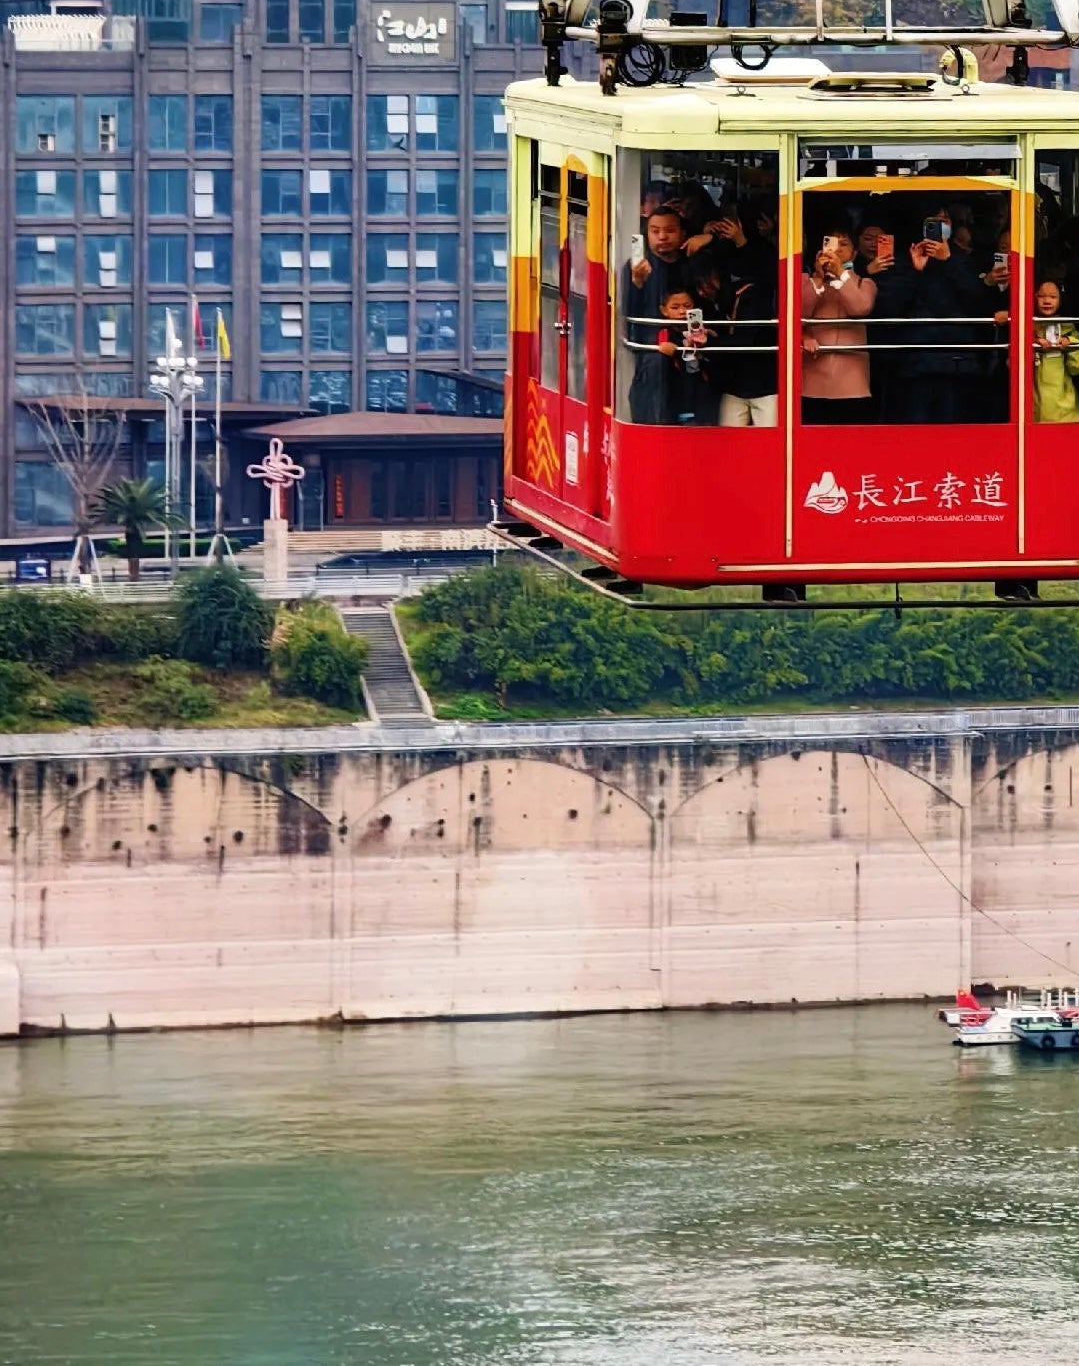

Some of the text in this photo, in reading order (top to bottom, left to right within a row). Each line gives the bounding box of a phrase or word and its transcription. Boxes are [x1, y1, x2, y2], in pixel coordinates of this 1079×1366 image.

[851, 471, 1009, 511] 長江索道
[869, 515, 915, 523] CHONGQING
[964, 514, 1004, 522] CABLEWAY
